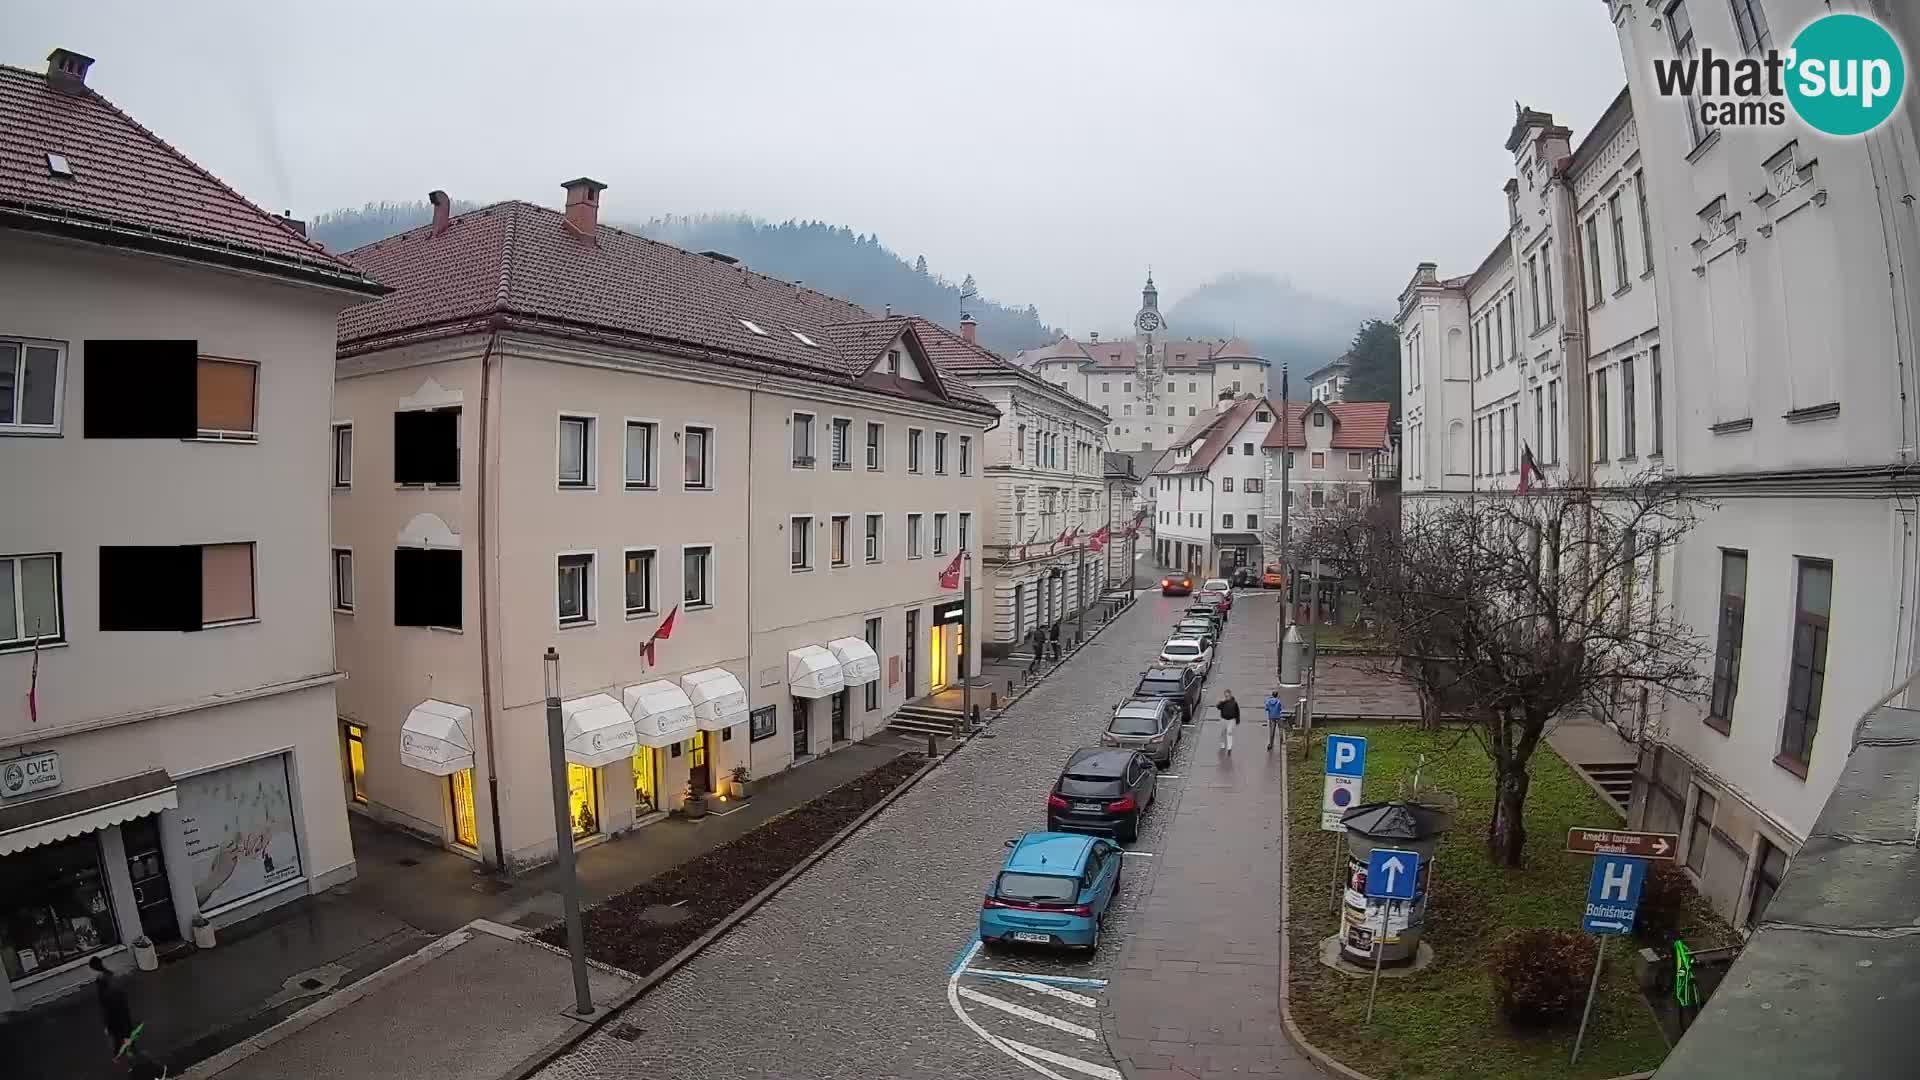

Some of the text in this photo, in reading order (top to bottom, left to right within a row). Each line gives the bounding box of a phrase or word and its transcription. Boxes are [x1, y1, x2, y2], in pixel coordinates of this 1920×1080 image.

[26, 758, 54, 775] CVET
[1335, 741, 1356, 769] P
[1600, 863, 1632, 901] H
